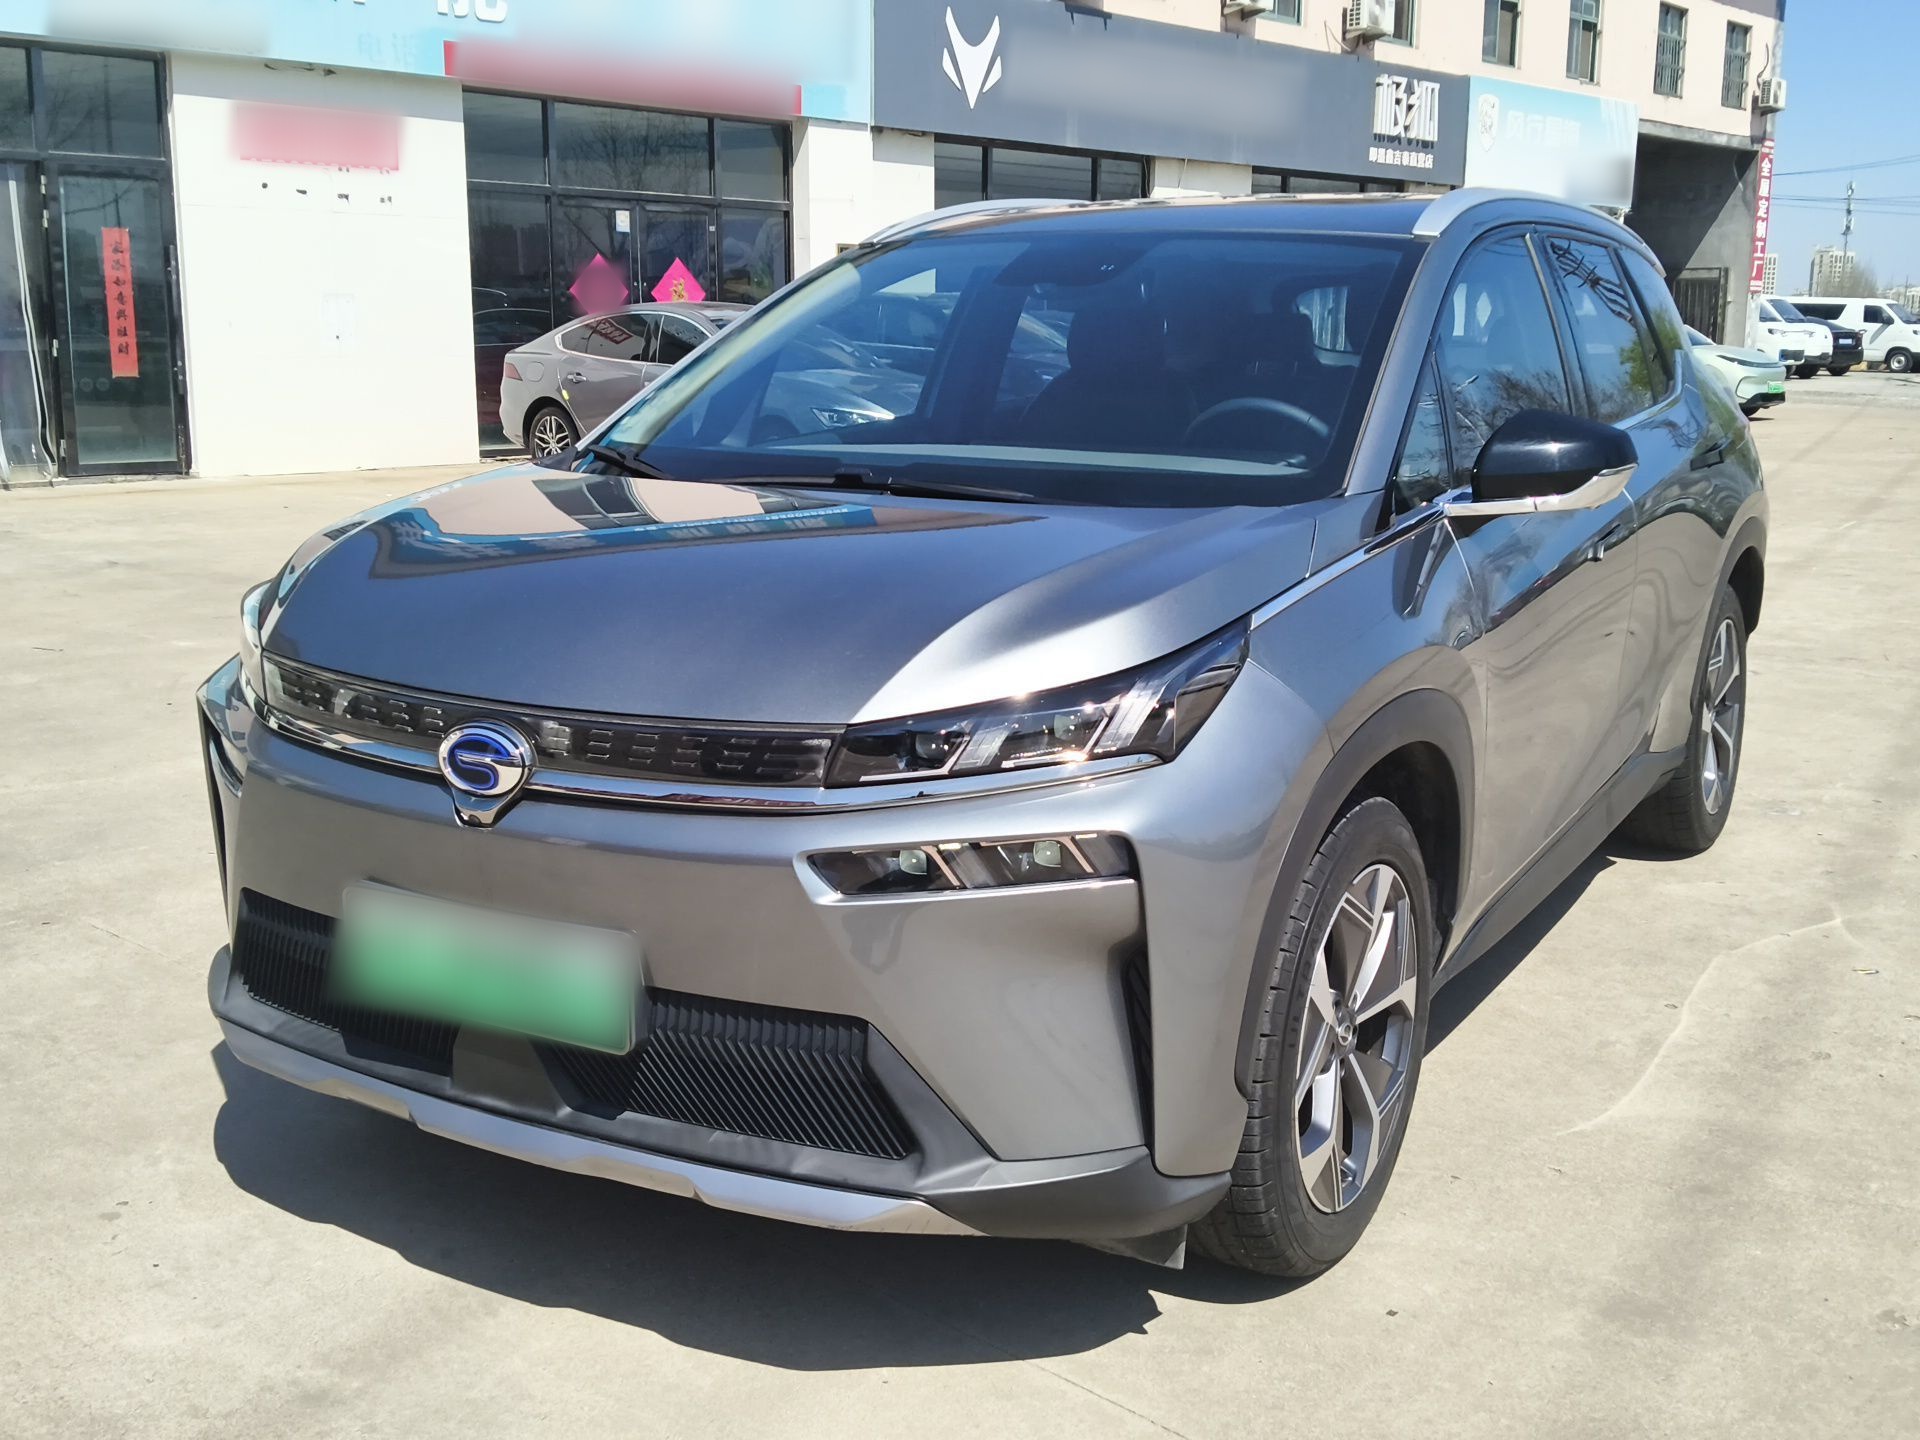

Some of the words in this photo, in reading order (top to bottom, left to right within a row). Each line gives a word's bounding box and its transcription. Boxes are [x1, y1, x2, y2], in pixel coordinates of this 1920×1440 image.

[1373, 73, 1440, 141] 极狐
[1752, 157, 1772, 278] 全屋定制工厂
